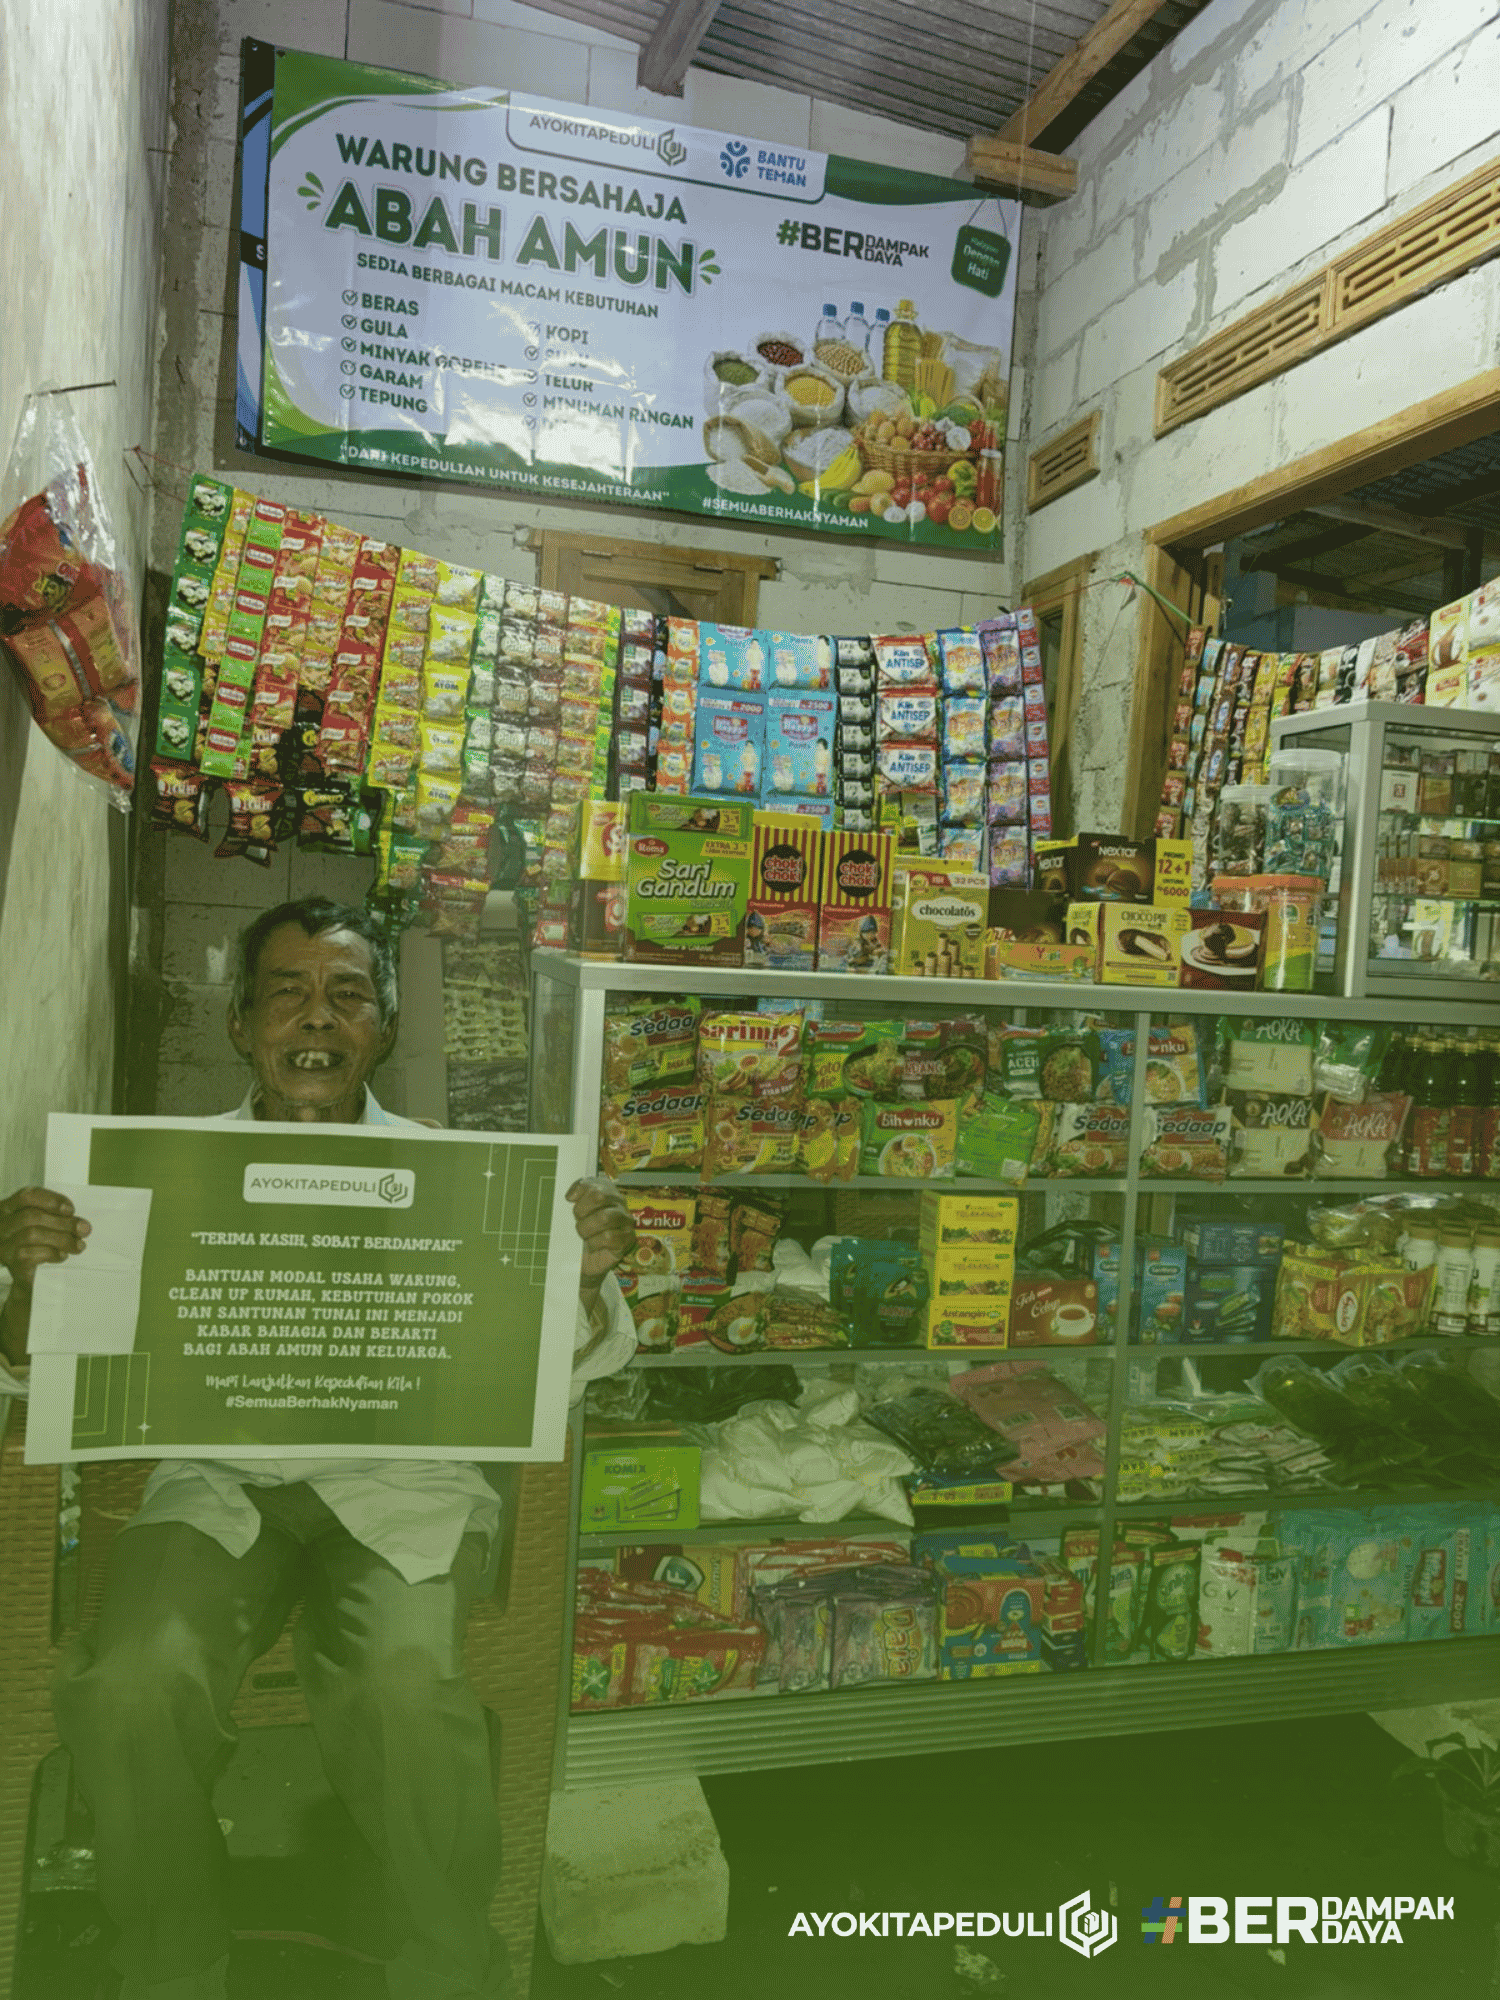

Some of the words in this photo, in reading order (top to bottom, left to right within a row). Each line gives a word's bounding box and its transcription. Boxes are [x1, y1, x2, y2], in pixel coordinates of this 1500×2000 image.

[529, 115, 655, 150] AYOKITAPEDULI
[758, 150, 806, 171] BANTU
[336, 133, 487, 186] WARUNG
[497, 162, 687, 224] BERSAHAJA
[758, 167, 807, 187] TEMAN
[325, 181, 501, 260] ABAH
[516, 215, 693, 294] AMUN
[776, 219, 864, 260] #BER
[866, 234, 930, 259] DAMPAK
[865, 249, 903, 267] DAYA
[357, 253, 408, 276] SEDIA
[411, 265, 496, 292] BERBAGAI
[501, 280, 560, 303] MACAM
[565, 289, 658, 318] KEBUTUHAN
[361, 293, 419, 316] BERAS
[361, 316, 408, 339] GULA
[546, 325, 589, 345] KOPI
[361, 341, 430, 367] MINYAK
[360, 364, 423, 390] GARAM
[545, 374, 593, 392] TELUR
[359, 387, 428, 414] TEPUNG
[543, 396, 624, 419] MINUMAN
[629, 406, 694, 429] RINGAN
[391, 453, 484, 477] KEPEDULIAN
[490, 467, 539, 487] UNTUK
[703, 498, 868, 528] #SEMUABERHAKNYAMAN
[657, 858, 713, 881] Sari
[637, 876, 737, 898] Gandum
[630, 1014, 695, 1037] Sedaa
[1008, 1056, 1040, 1069] ACEH
[250, 1177, 376, 1193] AYOKITAPEDULI
[260, 1233, 308, 1247] KASIH,
[311, 1235, 361, 1249] SOBAT
[185, 1269, 265, 1283] BANTUAN
[270, 1270, 325, 1284] MODAL
[331, 1272, 383, 1285] USAHA
[389, 1273, 461, 1289] WARUNG,
[169, 1287, 223, 1301] CLEAN
[229, 1288, 249, 1300] UP
[254, 1288, 315, 1303] RUMAH,
[321, 1290, 416, 1304] KEBUTUHAN
[422, 1292, 474, 1306] POKOK
[177, 1306, 212, 1319] DAN
[217, 1307, 306, 1320] SANTUNAN
[312, 1308, 360, 1321] TUNAI
[365, 1309, 389, 1321] INI
[393, 1310, 462, 1323] MENJADI
[197, 1324, 252, 1337] KABAR
[258, 1325, 327, 1338] BAHAGIA
[332, 1326, 365, 1339] DAN
[370, 1327, 437, 1340] BERARTI
[183, 1342, 222, 1356] BAGI
[227, 1343, 270, 1356] ABAH
[276, 1343, 323, 1357] AMUN
[329, 1344, 361, 1357] DAN
[366, 1345, 451, 1359] KELUARGA.
[206, 1375, 238, 1390] Mari
[242, 1374, 311, 1391] Lanjutkan
[226, 1394, 398, 1411] #SemuaBerhakNyaman
[604, 1464, 647, 1475] KOMIX
